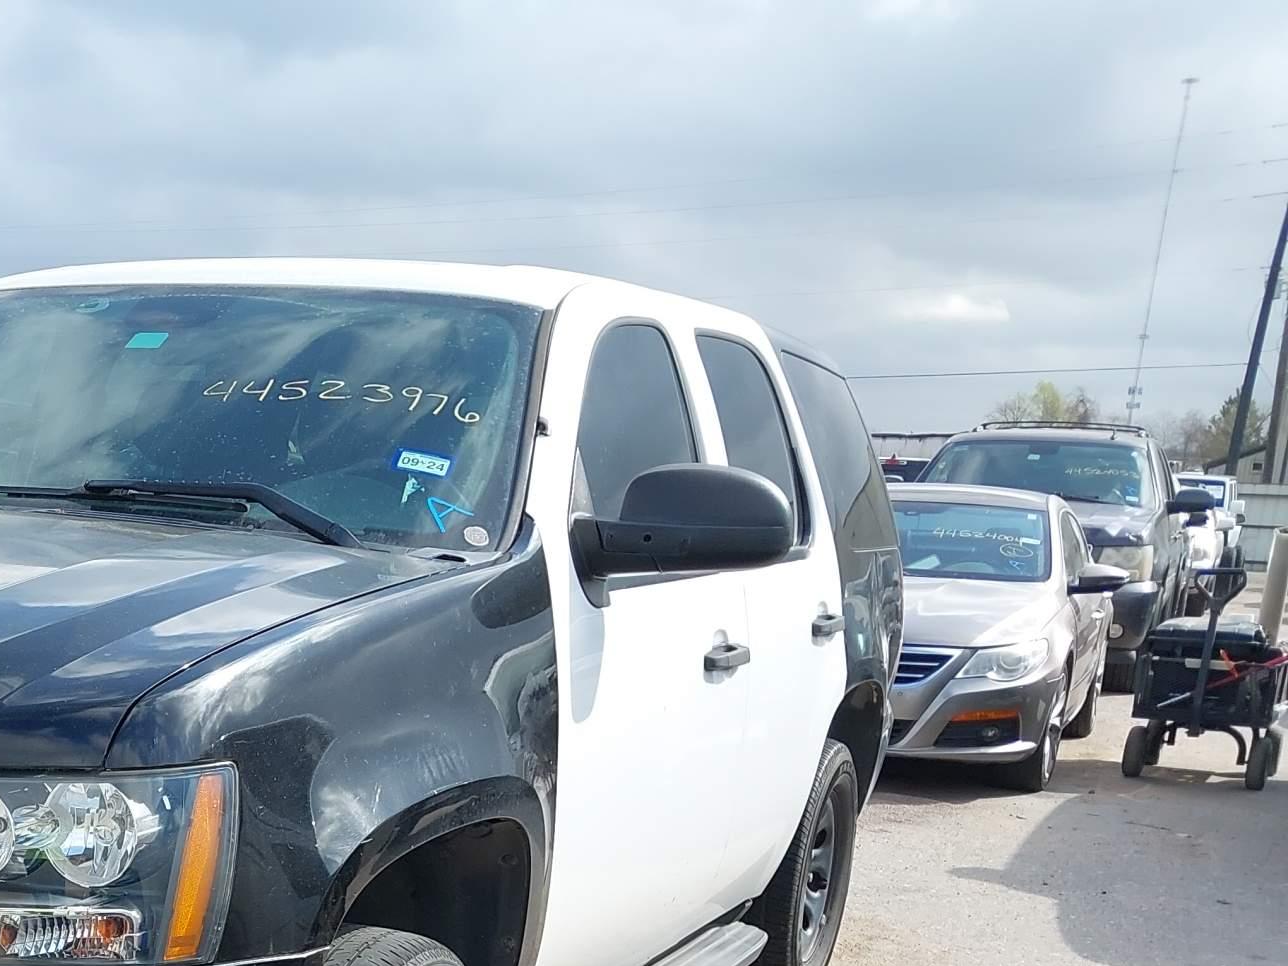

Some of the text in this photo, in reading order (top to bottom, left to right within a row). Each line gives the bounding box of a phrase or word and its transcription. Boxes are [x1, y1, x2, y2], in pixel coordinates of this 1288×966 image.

[203, 378, 481, 423] 44523976
[401, 456, 446, 472] 09 24
[427, 496, 475, 534] A
